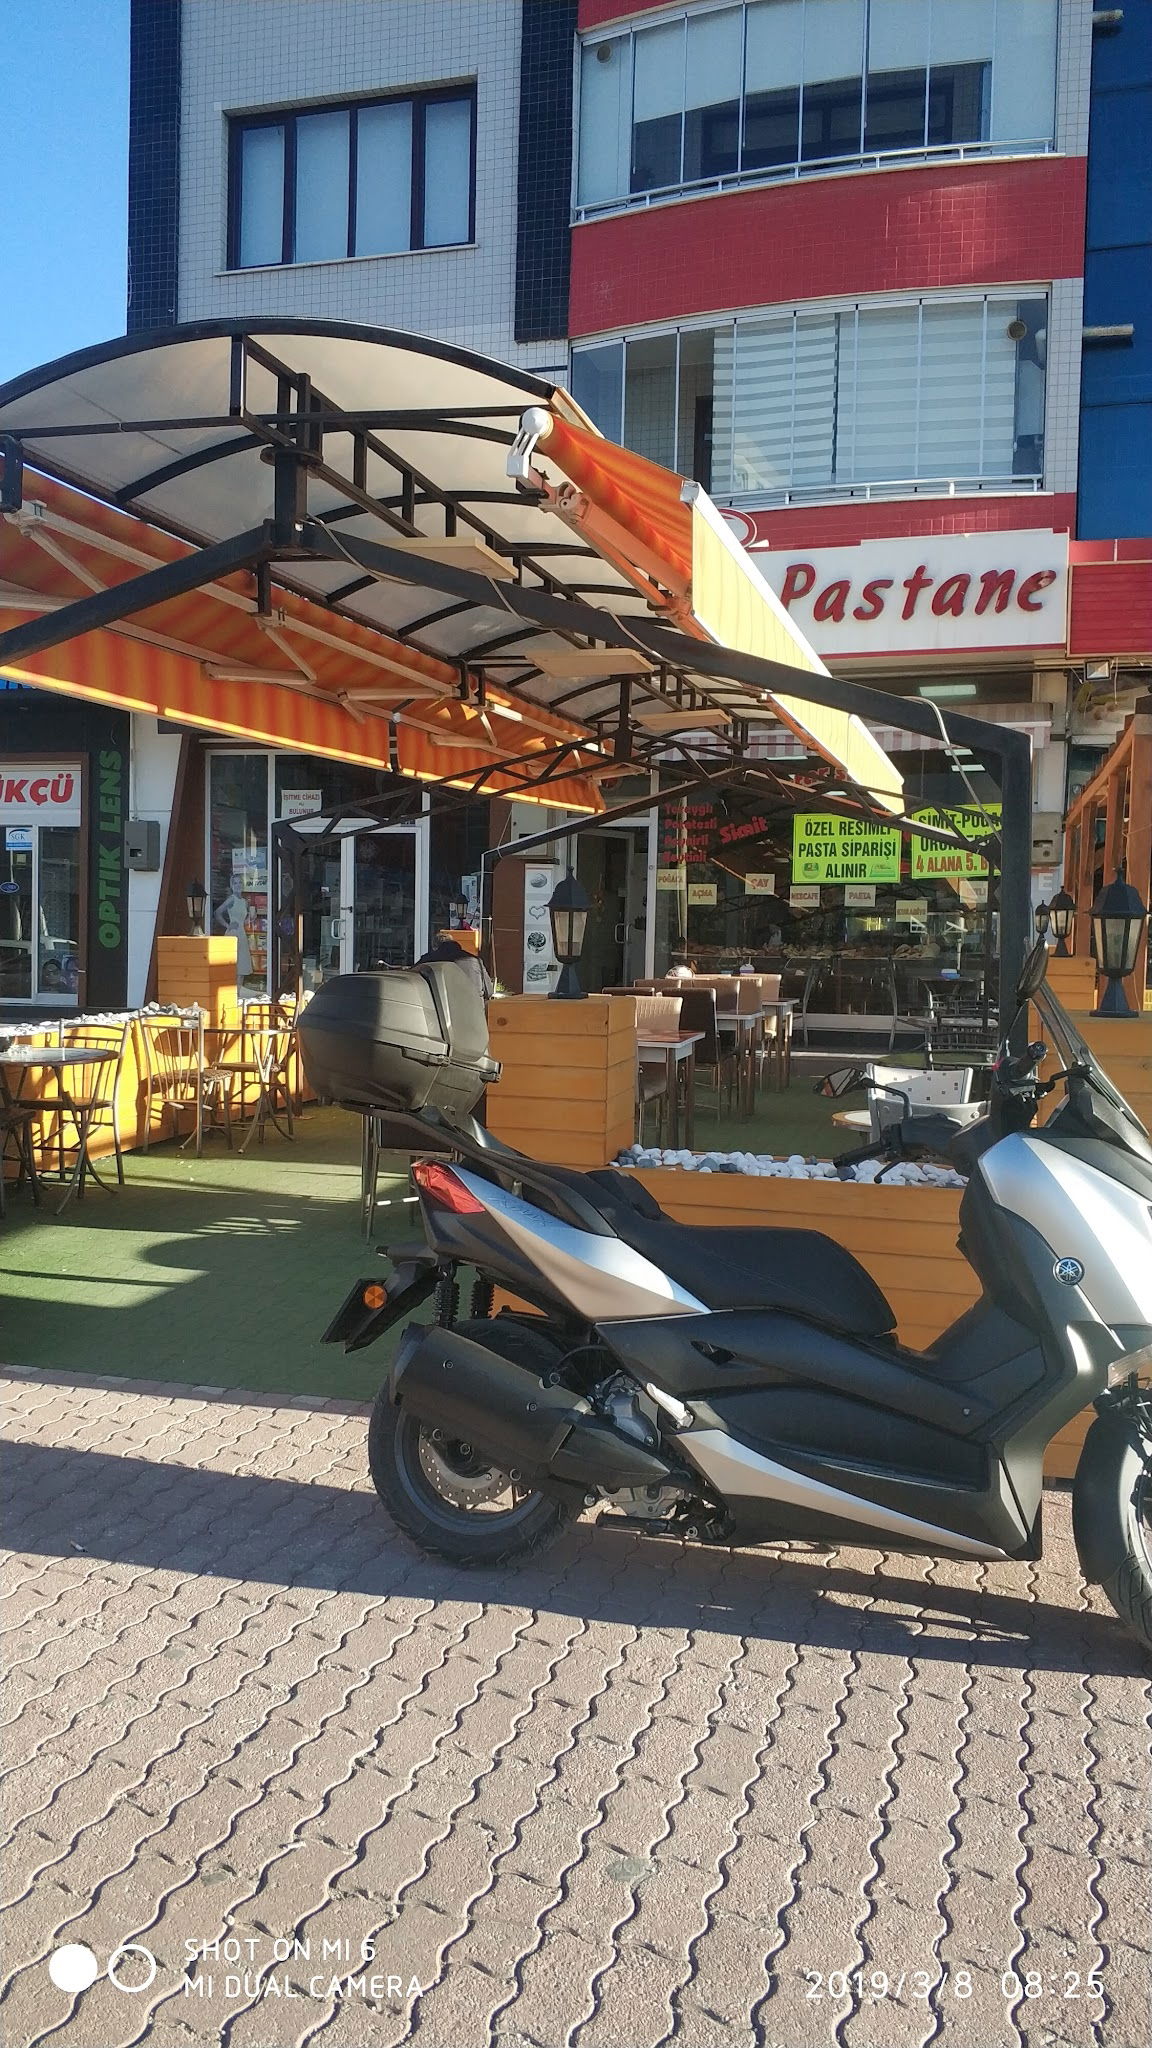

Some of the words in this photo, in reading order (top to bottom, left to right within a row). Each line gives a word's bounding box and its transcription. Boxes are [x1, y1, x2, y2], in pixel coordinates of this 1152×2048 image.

[779, 562, 1057, 623] Pastane
[0, 773, 74, 806] KÇÜ
[99, 750, 122, 834] LENS
[719, 816, 768, 844] Simit
[804, 818, 835, 837] ÖZEL
[798, 842, 837, 858] PASTA
[841, 838, 896, 861] SİPARİŞİ
[825, 863, 867, 879] ALINIR
[916, 854, 924, 873] 4
[926, 855, 963, 873] ALANA
